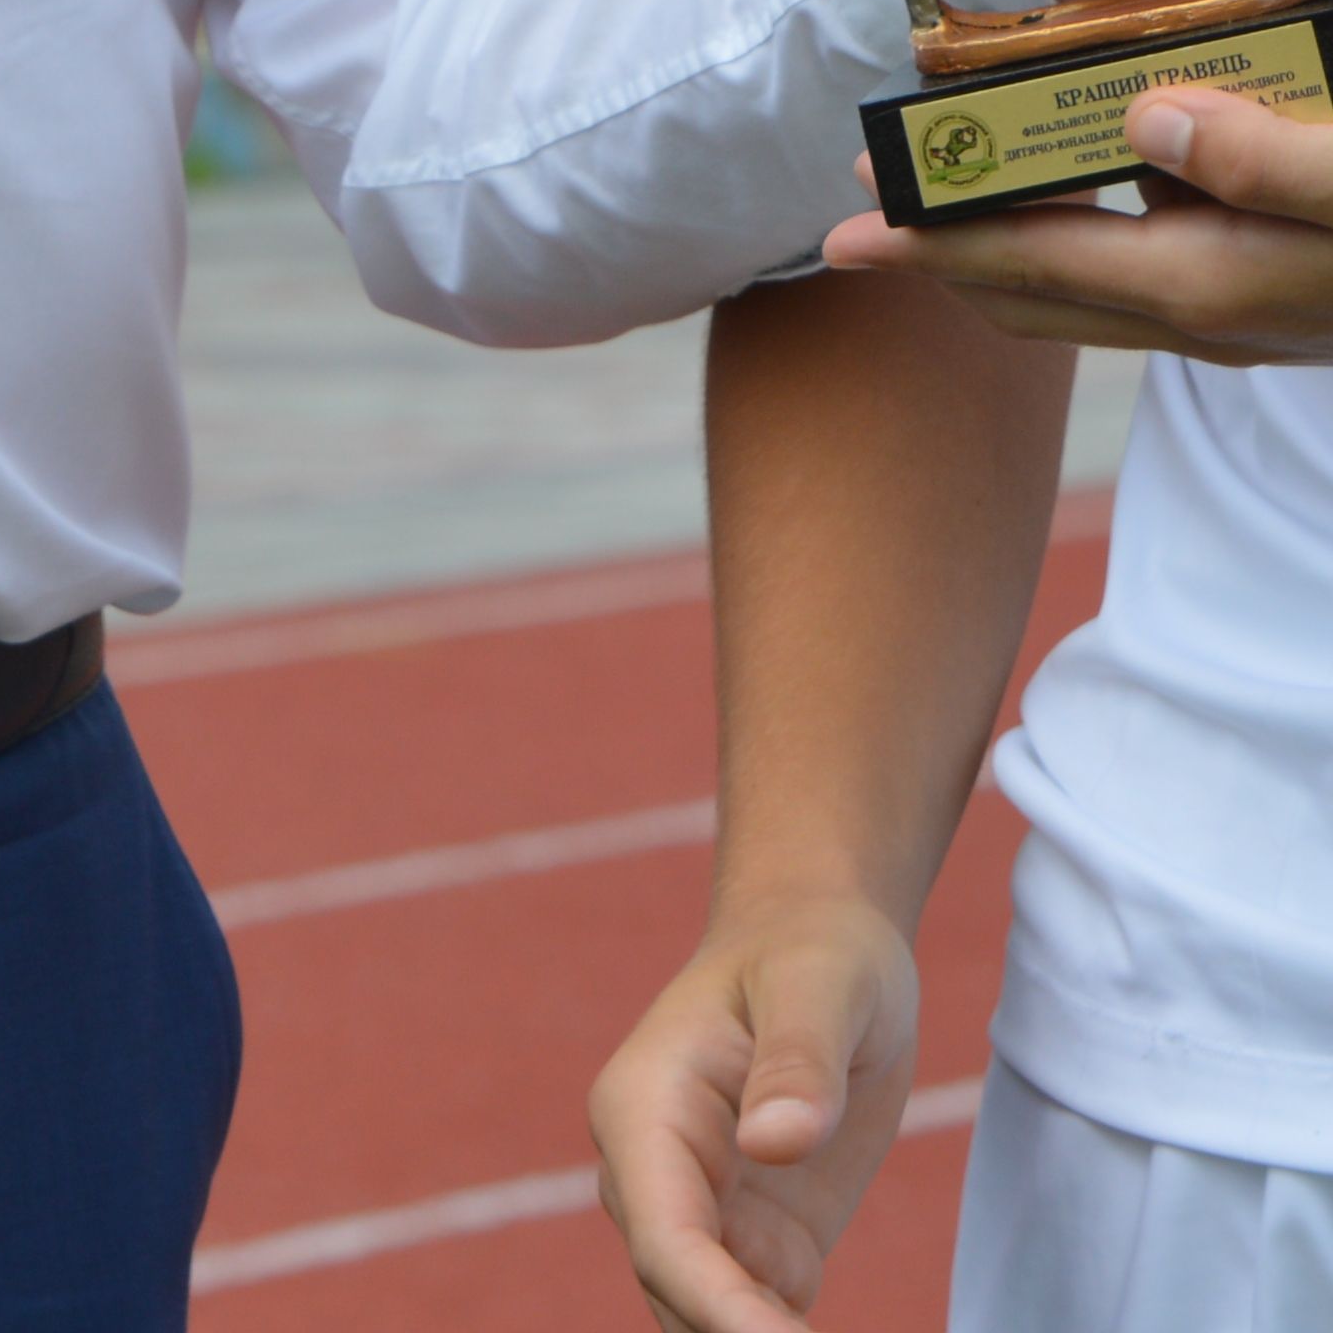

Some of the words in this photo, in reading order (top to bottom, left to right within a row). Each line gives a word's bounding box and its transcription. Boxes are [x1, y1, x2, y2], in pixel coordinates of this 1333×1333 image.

[1054, 70, 1149, 110] КРАЩИЙ
[1154, 53, 1252, 86] ГРАВЕЦЬ
[1022, 112, 1102, 137] ФІНАЛЬНОГО
[1004, 126, 1126, 163] ДИТЯЧО-ЮНАЦЬКОГ
